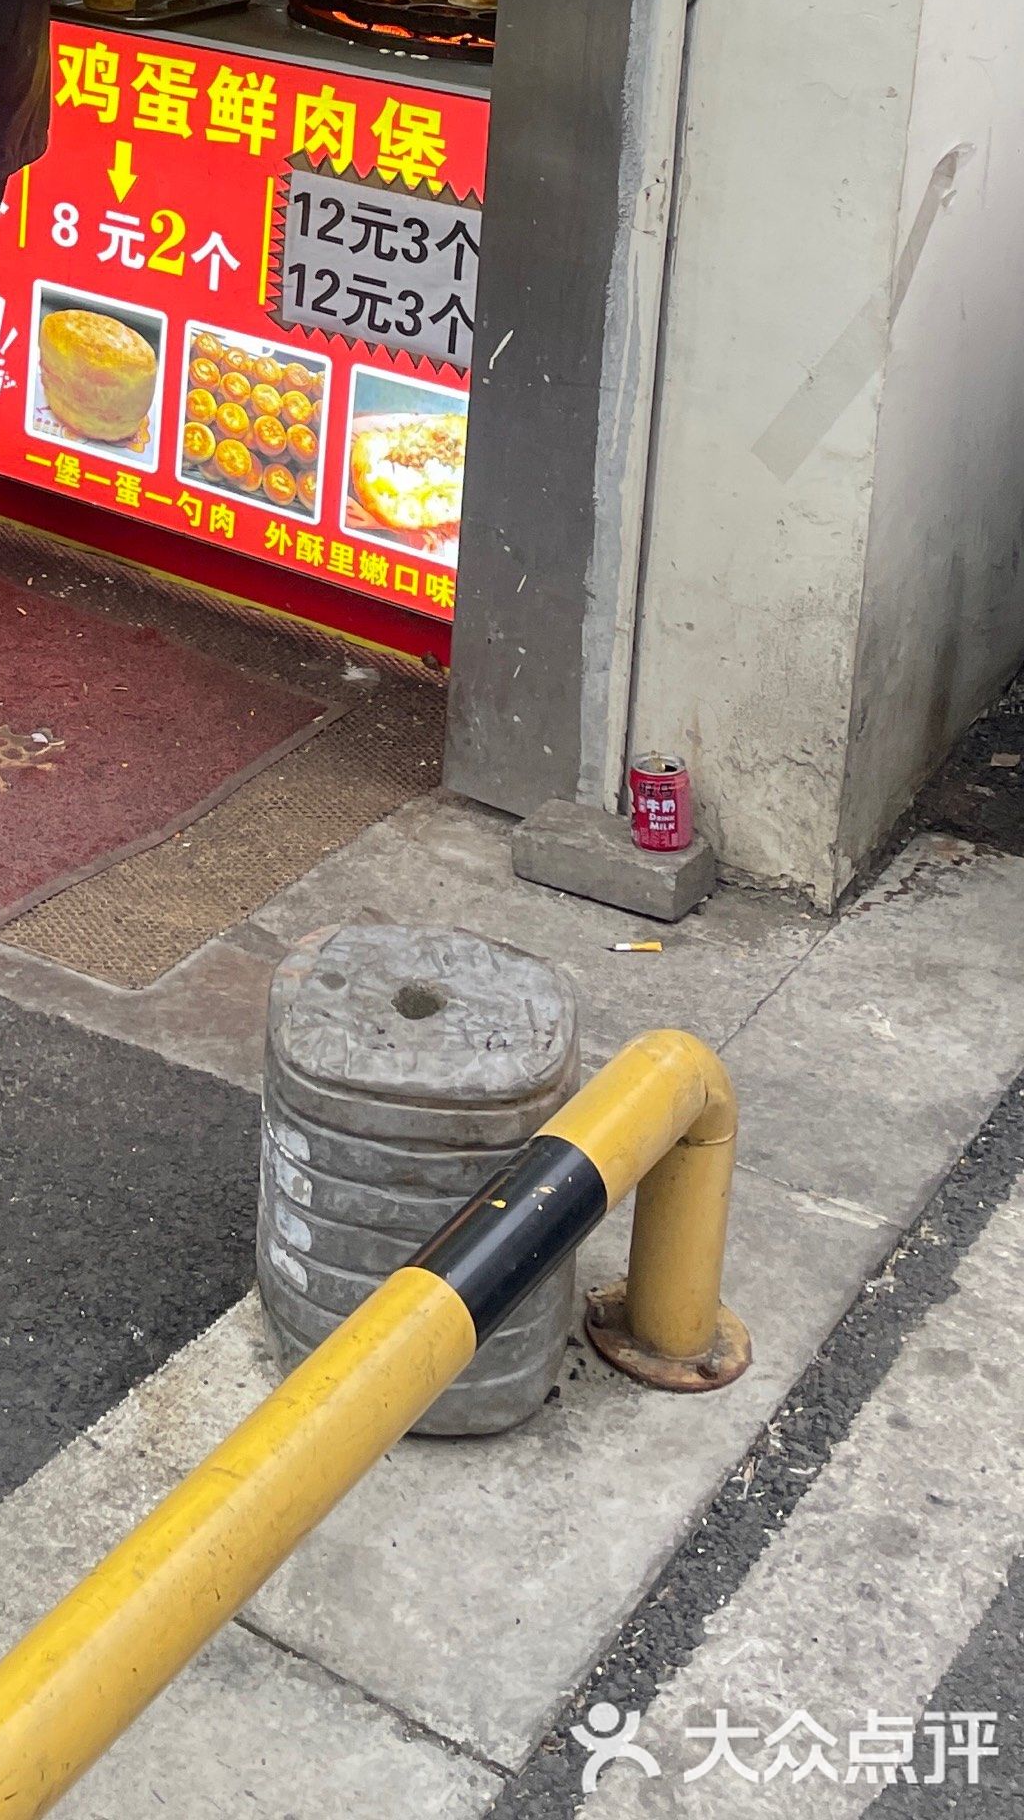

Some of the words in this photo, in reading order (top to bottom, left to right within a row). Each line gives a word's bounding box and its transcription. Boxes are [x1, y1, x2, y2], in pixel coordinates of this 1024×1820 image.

[55, 42, 447, 194] 鸡蛋鲜肉堡
[294, 193, 479, 280] 12元3个
[288, 263, 474, 355] 12元3个
[25, 452, 236, 539] 一堡一蛋一勺肉
[265, 521, 455, 608] 外酥里嫩口味
